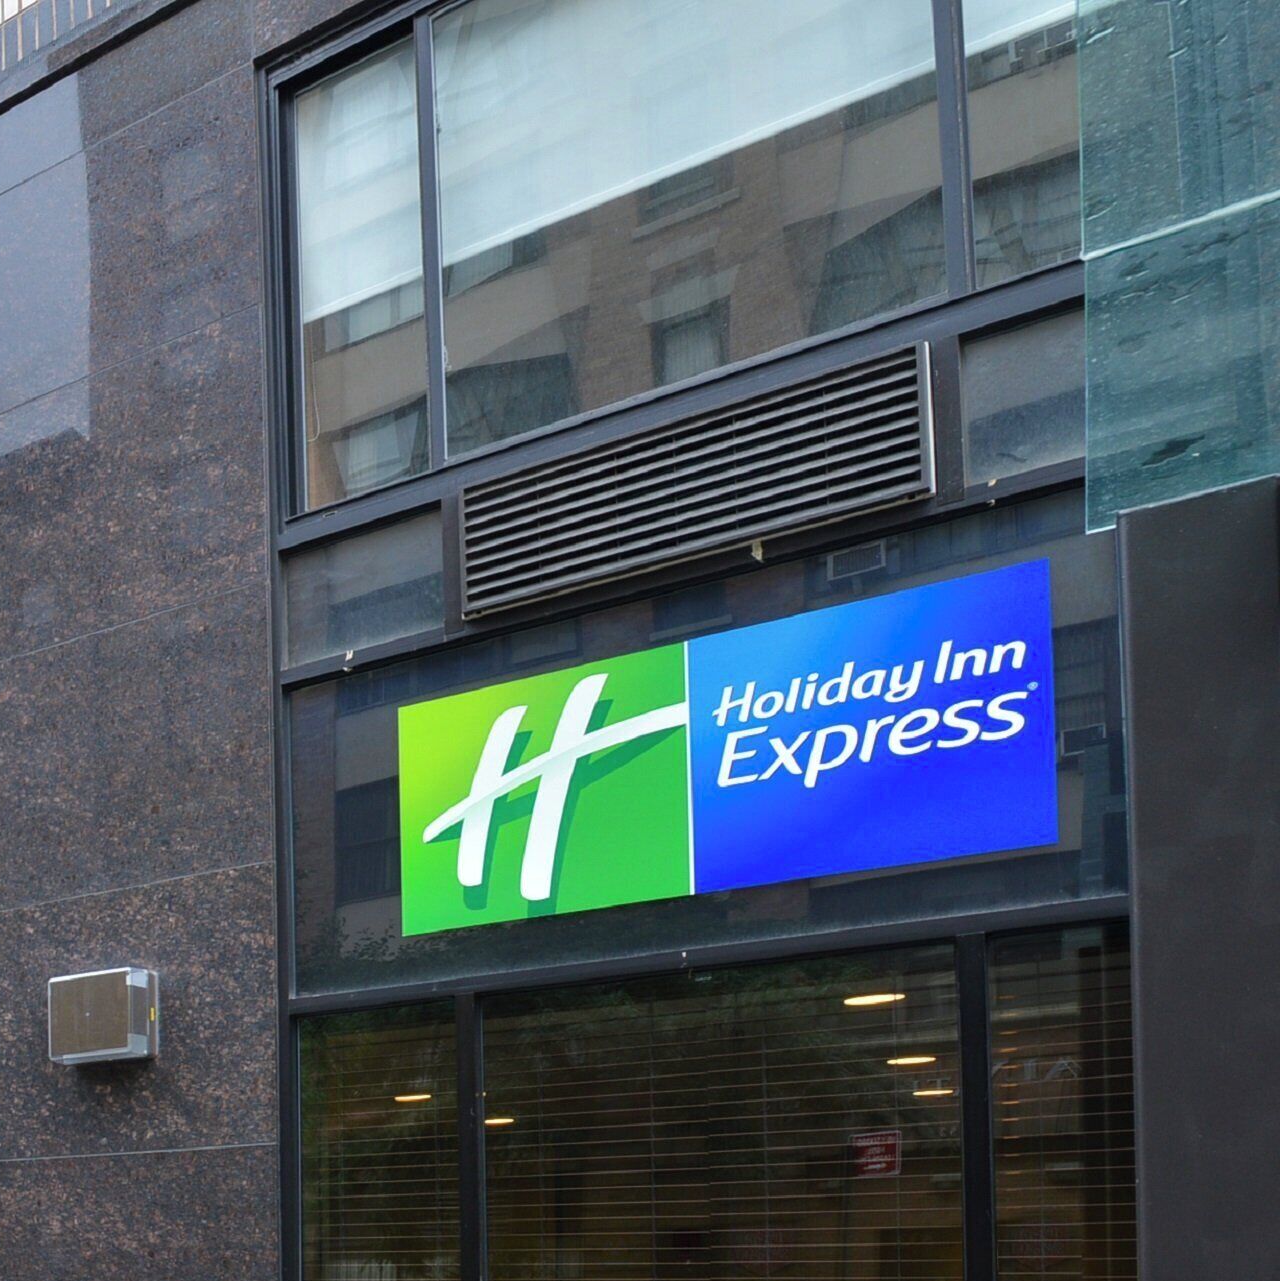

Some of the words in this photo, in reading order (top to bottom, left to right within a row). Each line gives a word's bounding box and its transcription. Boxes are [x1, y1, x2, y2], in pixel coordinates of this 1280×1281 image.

[712, 660, 925, 727] Holiday
[933, 639, 1027, 684] Inn
[716, 690, 1029, 789] Express
